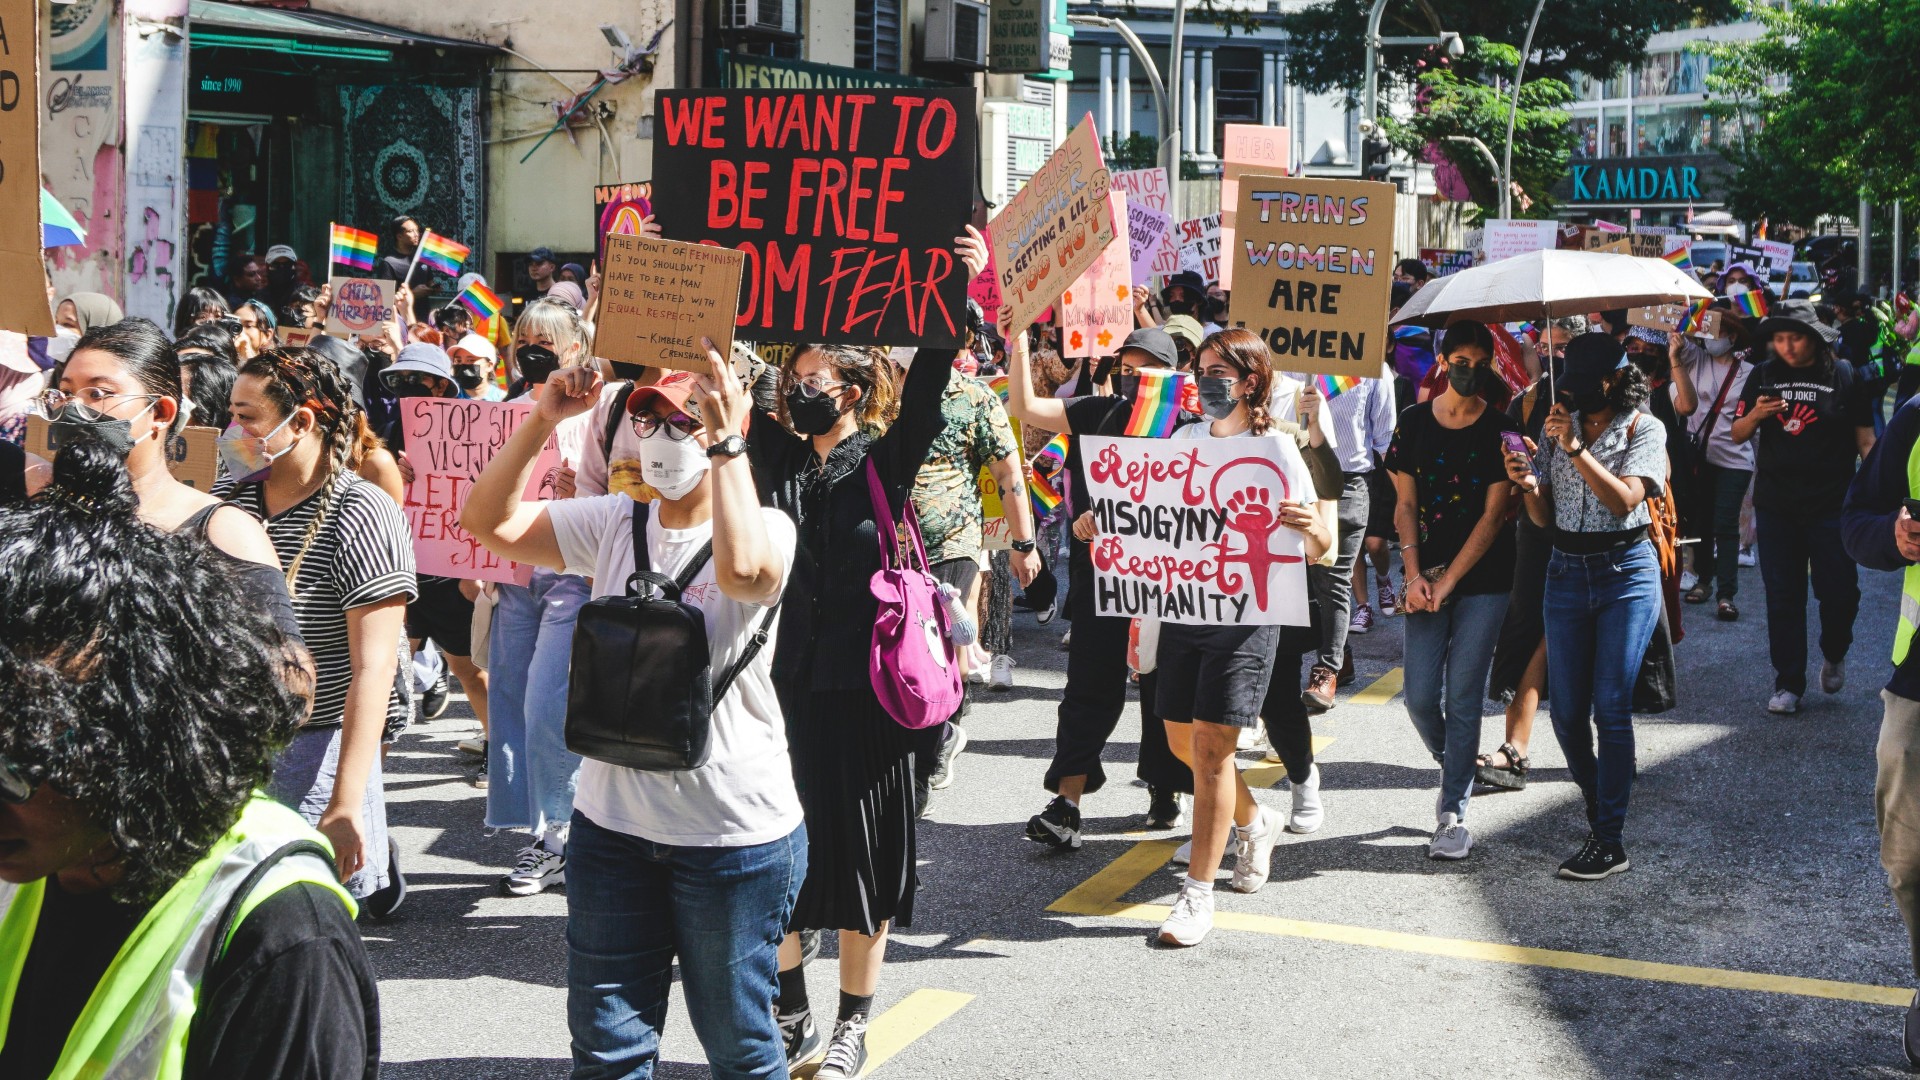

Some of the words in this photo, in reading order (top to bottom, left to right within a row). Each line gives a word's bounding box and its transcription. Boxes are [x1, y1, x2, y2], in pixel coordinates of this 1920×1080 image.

[201, 75, 221, 91] since
[224, 77, 242, 92] 1990
[663, 96, 726, 148] WE
[745, 94, 875, 151] WANT
[893, 95, 957, 159] TO
[1236, 136, 1275, 160] HER
[595, 186, 620, 204] MY
[1143, 169, 1163, 193] OF
[1573, 164, 1701, 200] KAMDAR
[707, 159, 770, 229] BE
[785, 157, 910, 243] FREE
[1007, 161, 1087, 262] SUMMER
[1251, 191, 1368, 226] TRANS
[1002, 268, 1013, 288] IS
[1015, 225, 1056, 274] GETTING
[1059, 217, 1066, 232] A
[1070, 196, 1088, 221] LIL
[1128, 221, 1155, 249] bably
[1182, 218, 1203, 243] SHE
[1203, 214, 1222, 232] TALK
[611, 254, 621, 262] IS
[628, 256, 647, 267] YOU
[653, 259, 705, 275] SHOULDN'T
[638, 241, 668, 253] POINT
[673, 247, 686, 256] OF
[689, 249, 741, 266] FEMINISM
[1244, 240, 1375, 276] WOMEN
[1435, 252, 1472, 265] TETAP
[609, 271, 634, 282] HAVE
[640, 274, 650, 282] TO
[654, 276, 665, 285] BE
[681, 278, 701, 289] MAN
[699, 240, 811, 331] OM
[819, 247, 957, 337] FEAR
[607, 302, 641, 316] EQUAL
[608, 287, 619, 296] TO
[624, 289, 634, 299] BE
[642, 290, 684, 303] TREATED
[691, 297, 715, 307] WITH
[1268, 279, 1341, 314] ARE
[660, 348, 708, 362] CRENSHAW
[1782, 390, 1792, 400] NO
[1794, 391, 1816, 402] JOKE!
[1792, 382, 1834, 393] HARASSMENT
[412, 400, 480, 441] STOP
[651, 461, 663, 469] 3M
[1089, 443, 1212, 506] Reject
[403, 473, 467, 511] LET
[1090, 496, 1228, 549] MISOGYNY
[1094, 534, 1246, 596] Respect
[1098, 576, 1249, 623] HUMANITY
